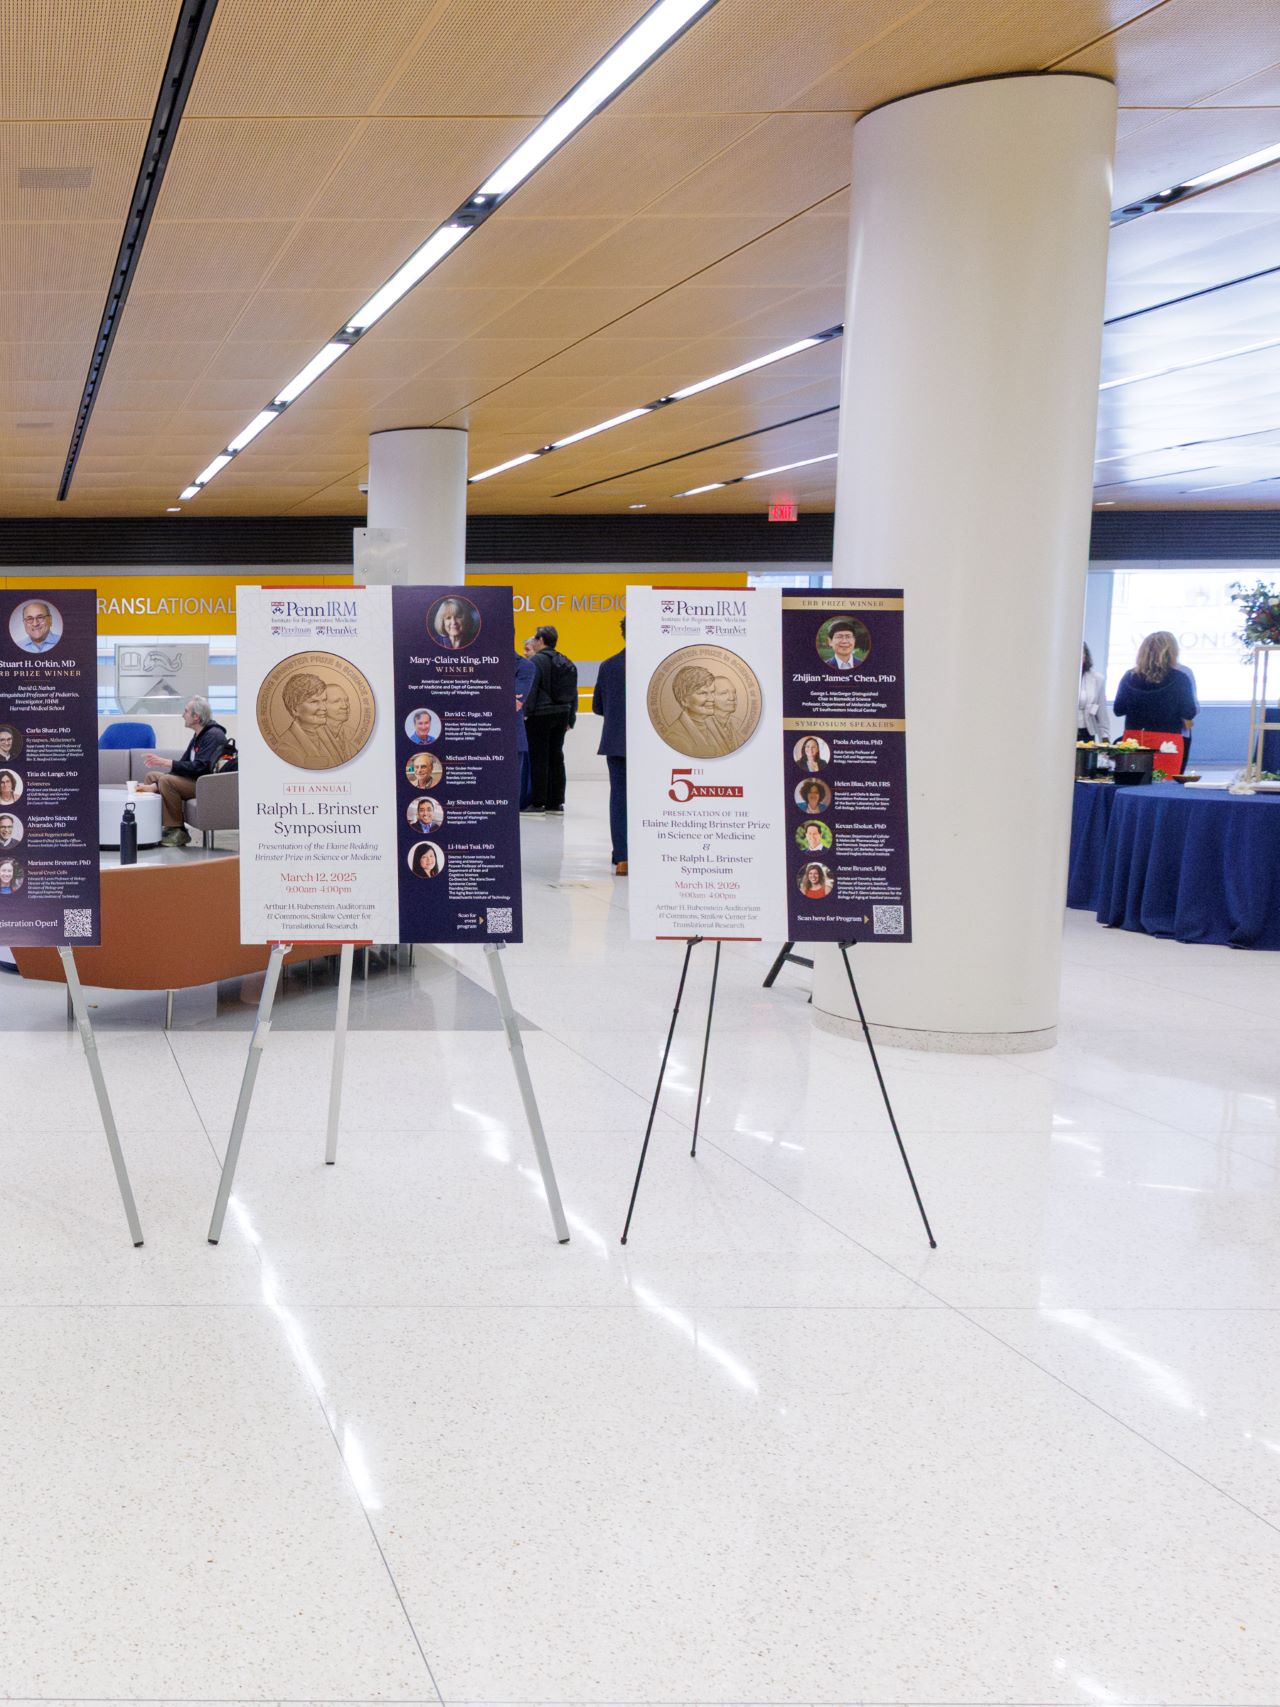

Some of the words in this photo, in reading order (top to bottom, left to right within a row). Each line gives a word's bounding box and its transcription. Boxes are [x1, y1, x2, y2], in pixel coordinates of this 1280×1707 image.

[96, 598, 236, 614] RANSLATIONAL
[541, 595, 566, 612] OF
[410, 657, 458, 665] Mary-Claire
[461, 657, 481, 665] King,
[793, 674, 820, 683] Zhijian
[854, 675, 877, 683] Chen,
[691, 788, 742, 796] ANNUAL
[257, 803, 297, 818] Ralph
[302, 803, 314, 814] L.
[319, 802, 378, 815] Brinster
[274, 821, 361, 837] Symposium
[671, 820, 707, 829] Redding
[748, 821, 770, 829] Prize
[715, 832, 755, 840] Medicine
[680, 855, 705, 863] Ralph
[717, 855, 753, 863] Brinster
[681, 866, 733, 875] Symposium
[281, 873, 313, 882] March
[331, 873, 357, 882] 2025
[675, 881, 703, 889] March
[35, 920, 58, 928] Open!
